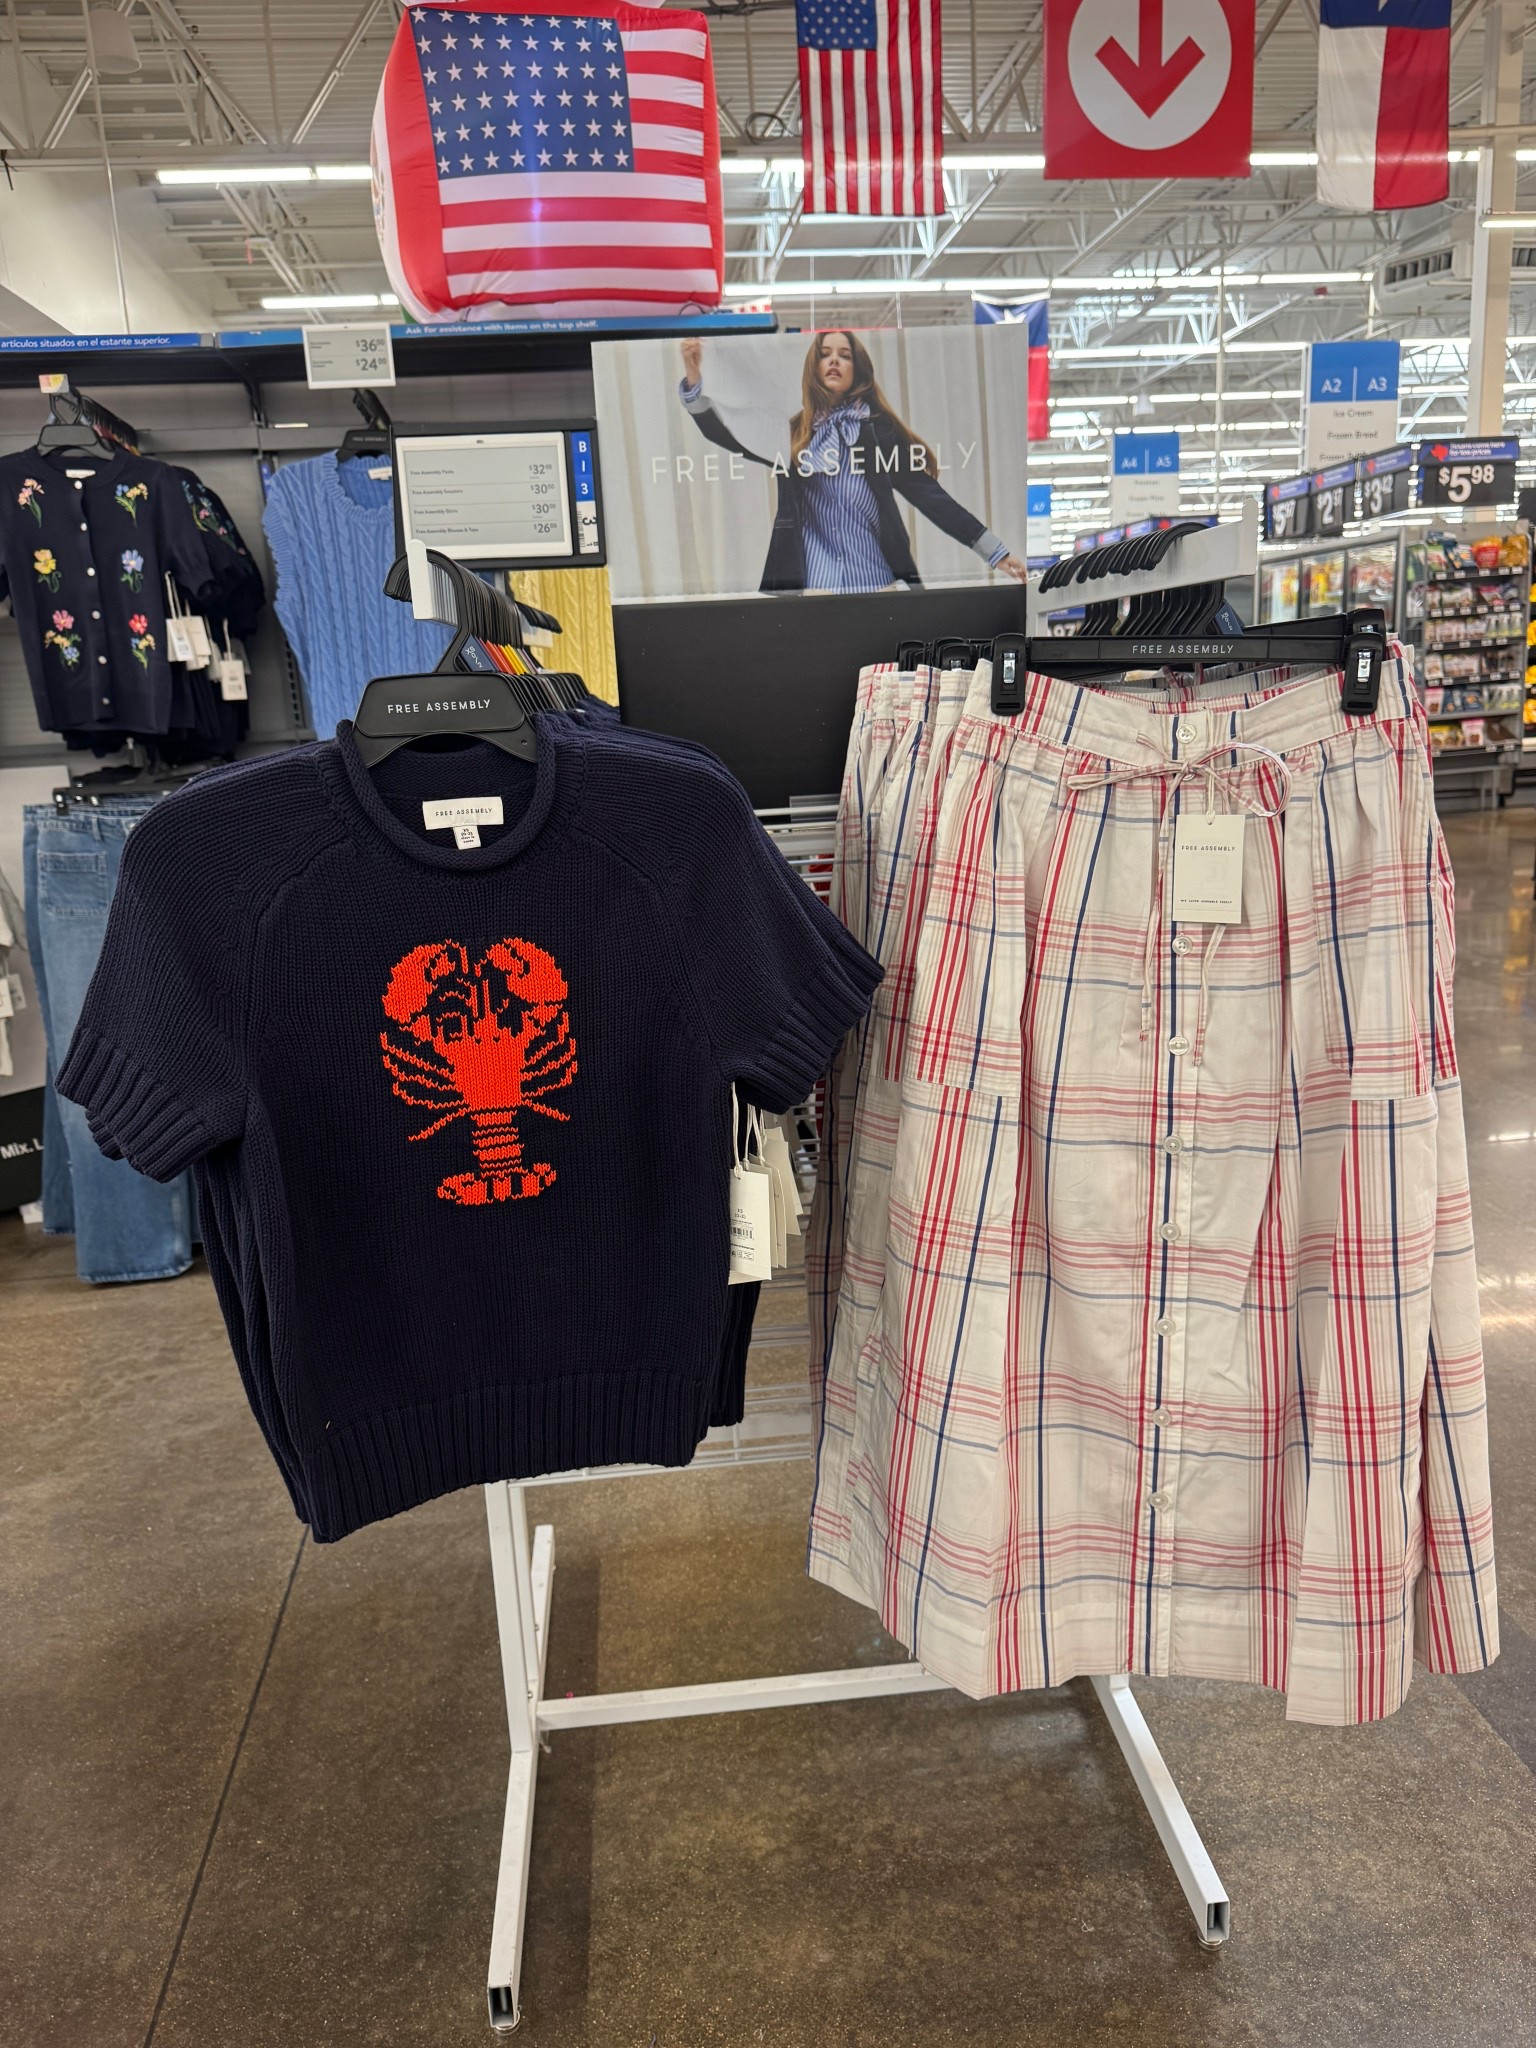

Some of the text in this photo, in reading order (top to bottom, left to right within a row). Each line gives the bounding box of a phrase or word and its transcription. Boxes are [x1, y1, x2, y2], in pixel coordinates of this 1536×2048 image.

[405, 326, 421, 335] Ask
[423, 325, 437, 334] for
[439, 323, 481, 333] assistance
[483, 322, 502, 332] with
[504, 322, 528, 331] items
[530, 322, 541, 330] on
[542, 320, 557, 330] the
[558, 320, 574, 331] top
[1, 335, 170, 348] artículos situados en el estante superior.
[1321, 378, 1342, 393] A2
[1367, 377, 1388, 391] A3
[1333, 407, 1374, 418] Ice Cream
[1327, 430, 1354, 440] Frozen
[651, 441, 977, 484] FREE ASSEMBLY
[1132, 644, 1234, 654] FREE ASSEMBLY
[387, 699, 491, 714] FREE ASSEMBLY
[456, 807, 493, 815] ASSEMBLY
[0, 1143, 33, 1159] Mix.
